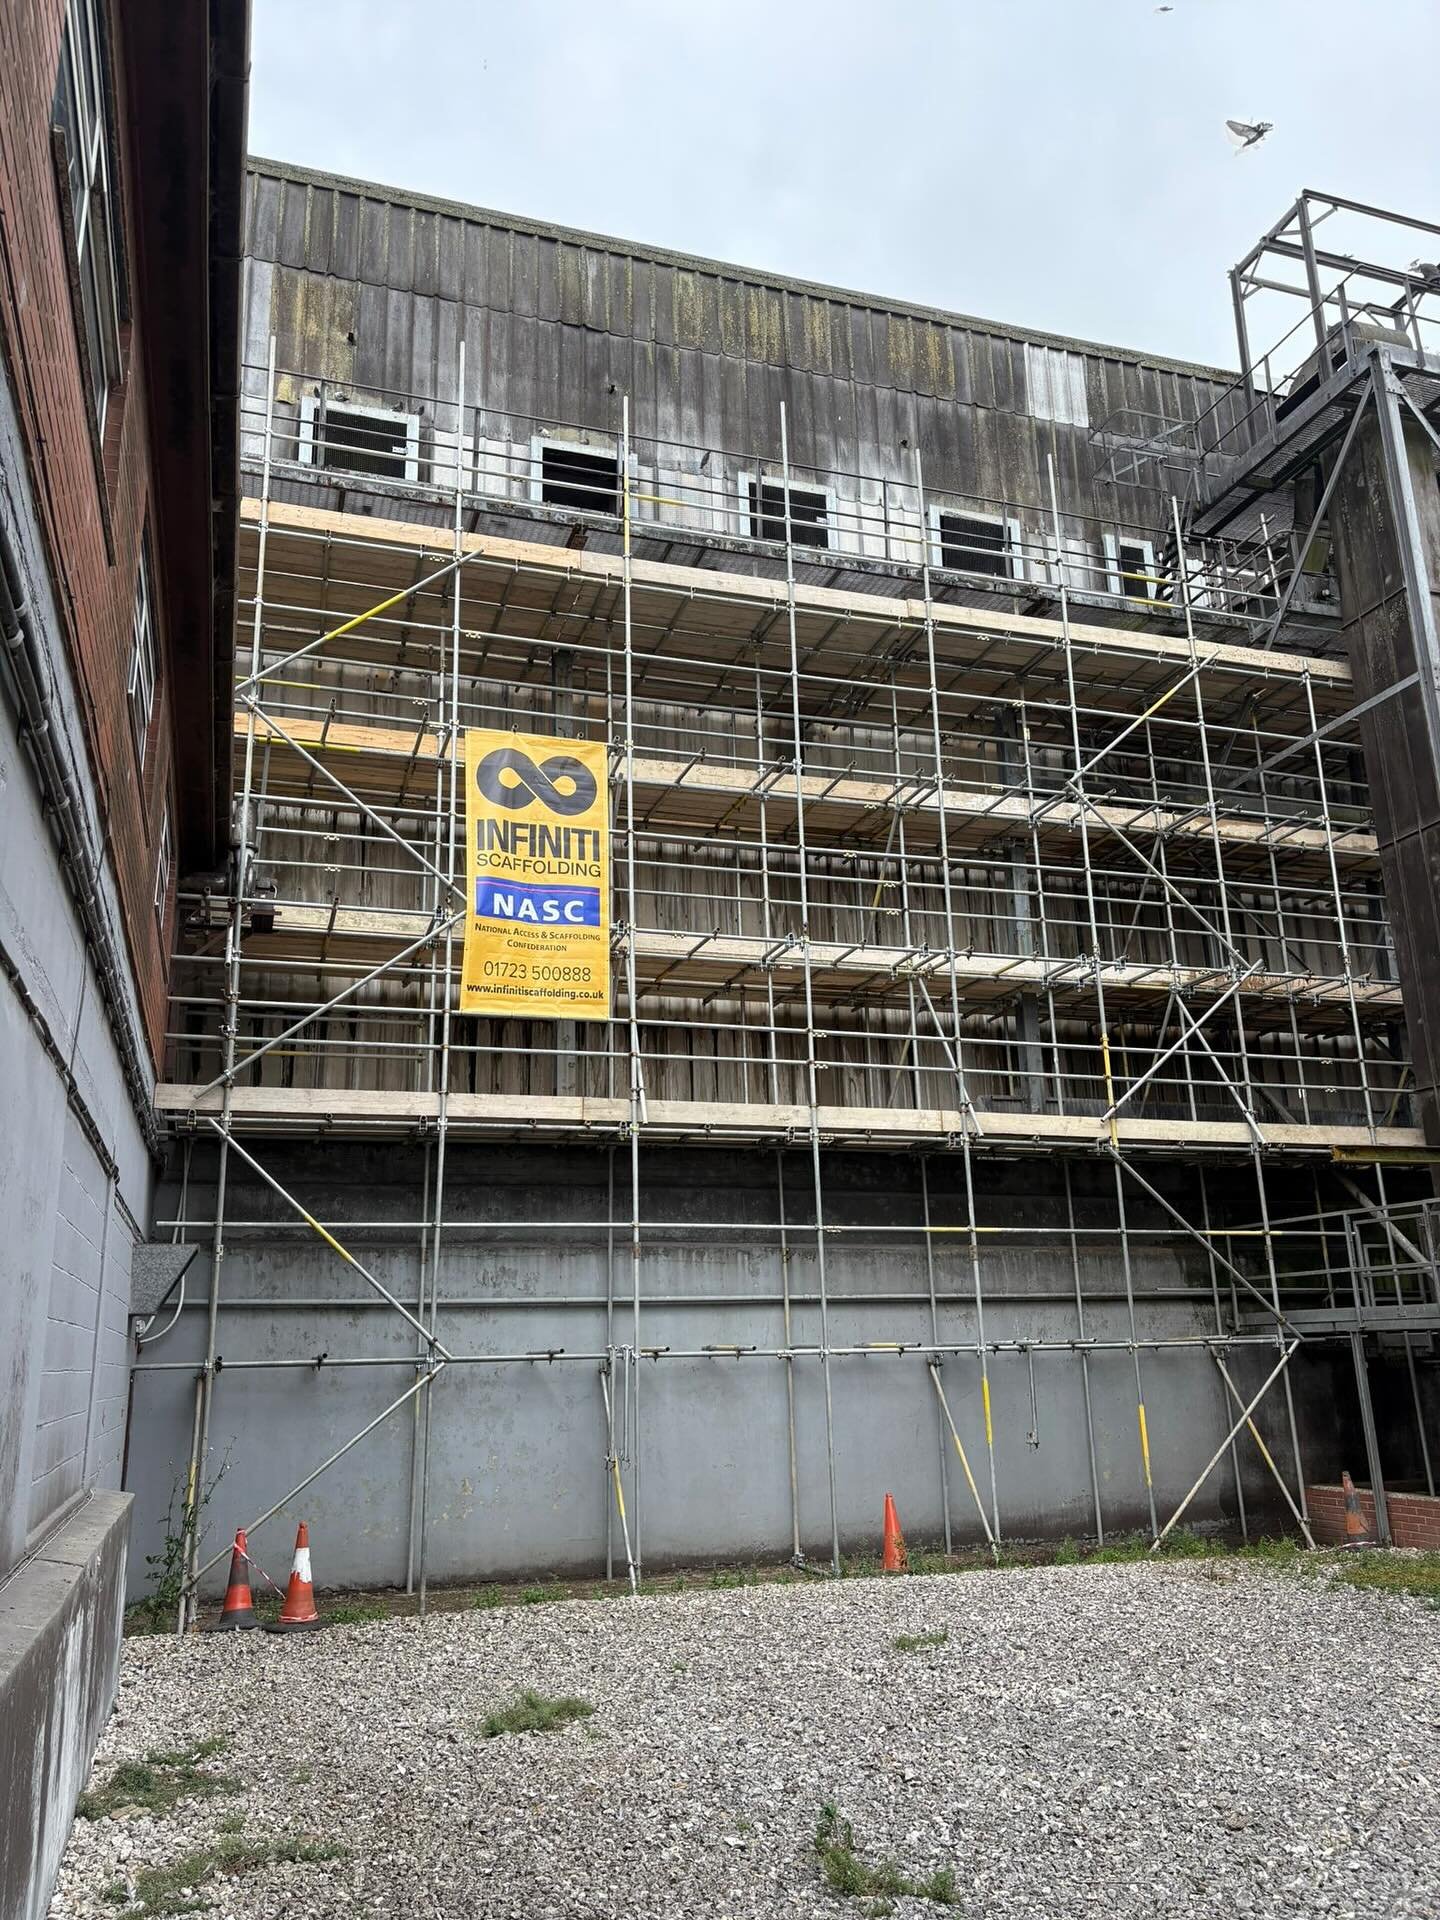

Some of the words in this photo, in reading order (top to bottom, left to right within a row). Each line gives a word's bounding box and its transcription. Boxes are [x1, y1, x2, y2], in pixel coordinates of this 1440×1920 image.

[477, 819, 600, 862] INFINITI
[477, 853, 601, 878] SCAFFOLDING
[493, 893, 584, 923] NASC
[541, 931, 549, 940] &
[484, 961, 527, 980] 01723
[532, 965, 592, 983] 500888
[466, 983, 604, 1001] www.infinitiscaffolding.co.uk
